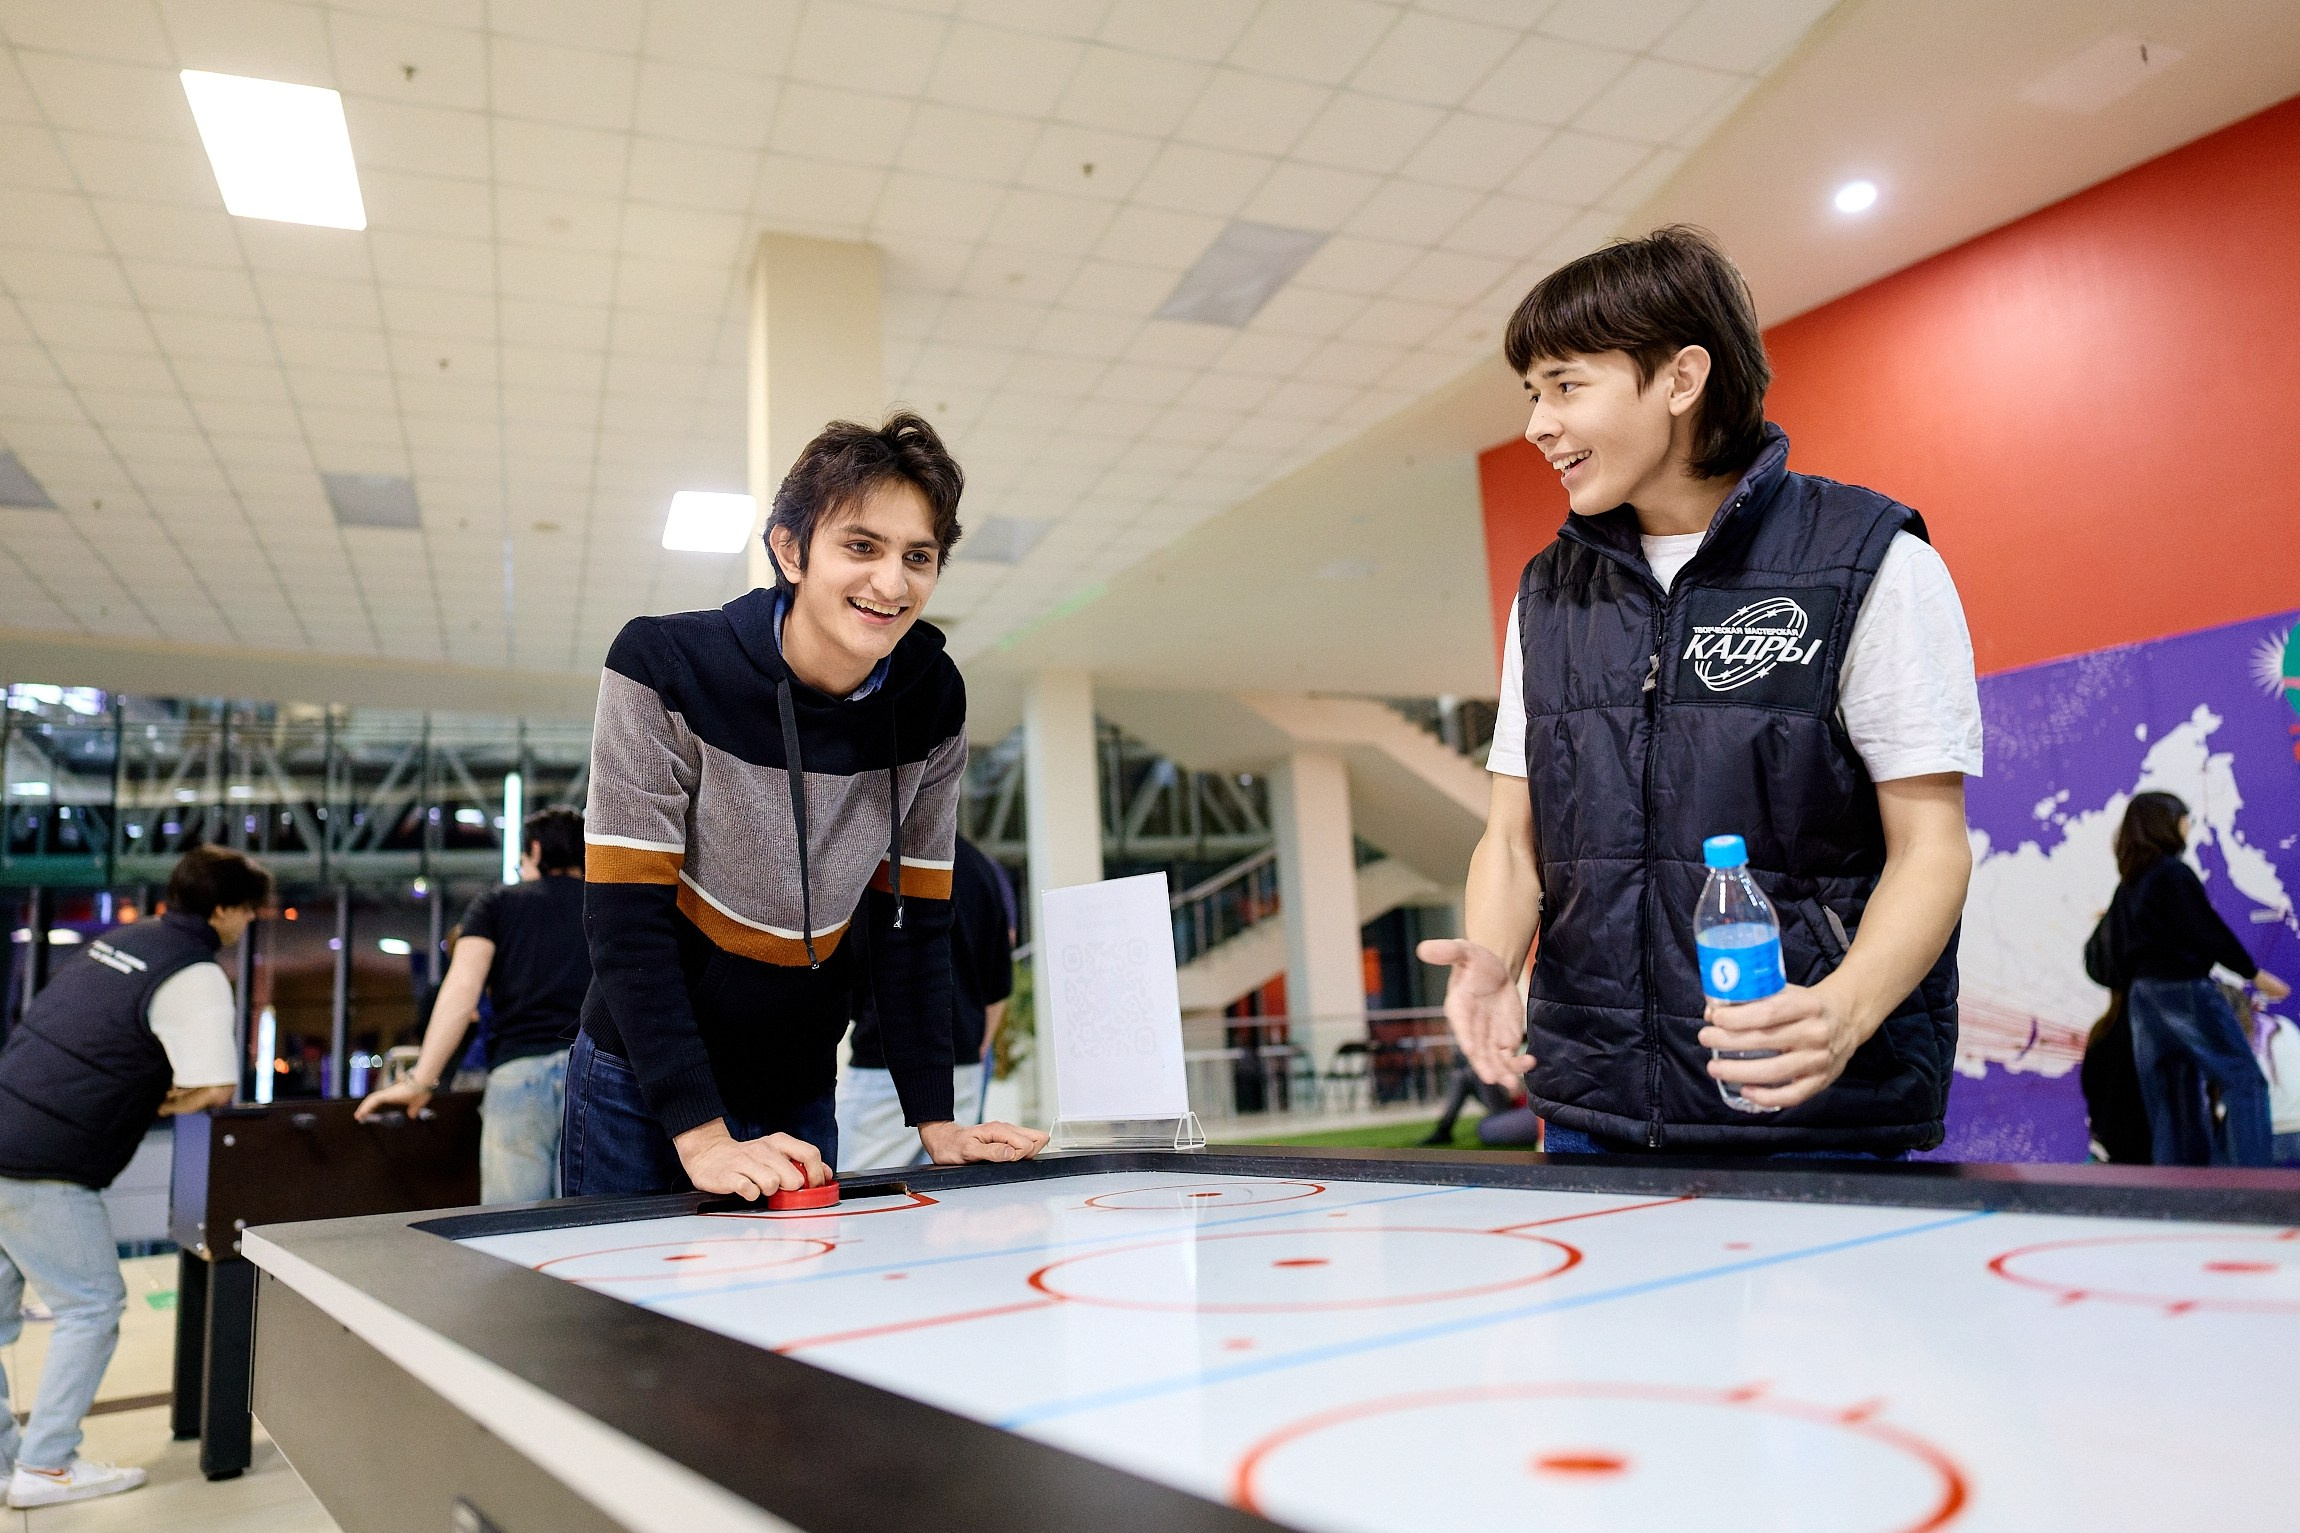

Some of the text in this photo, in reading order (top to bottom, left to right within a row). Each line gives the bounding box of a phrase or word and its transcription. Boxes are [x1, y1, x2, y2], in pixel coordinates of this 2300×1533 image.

[1692, 626, 1799, 636] ТВОРЧЕСКАЯ МАСТЕРСКАЯ
[1682, 634, 1823, 665] КАДРЫ
